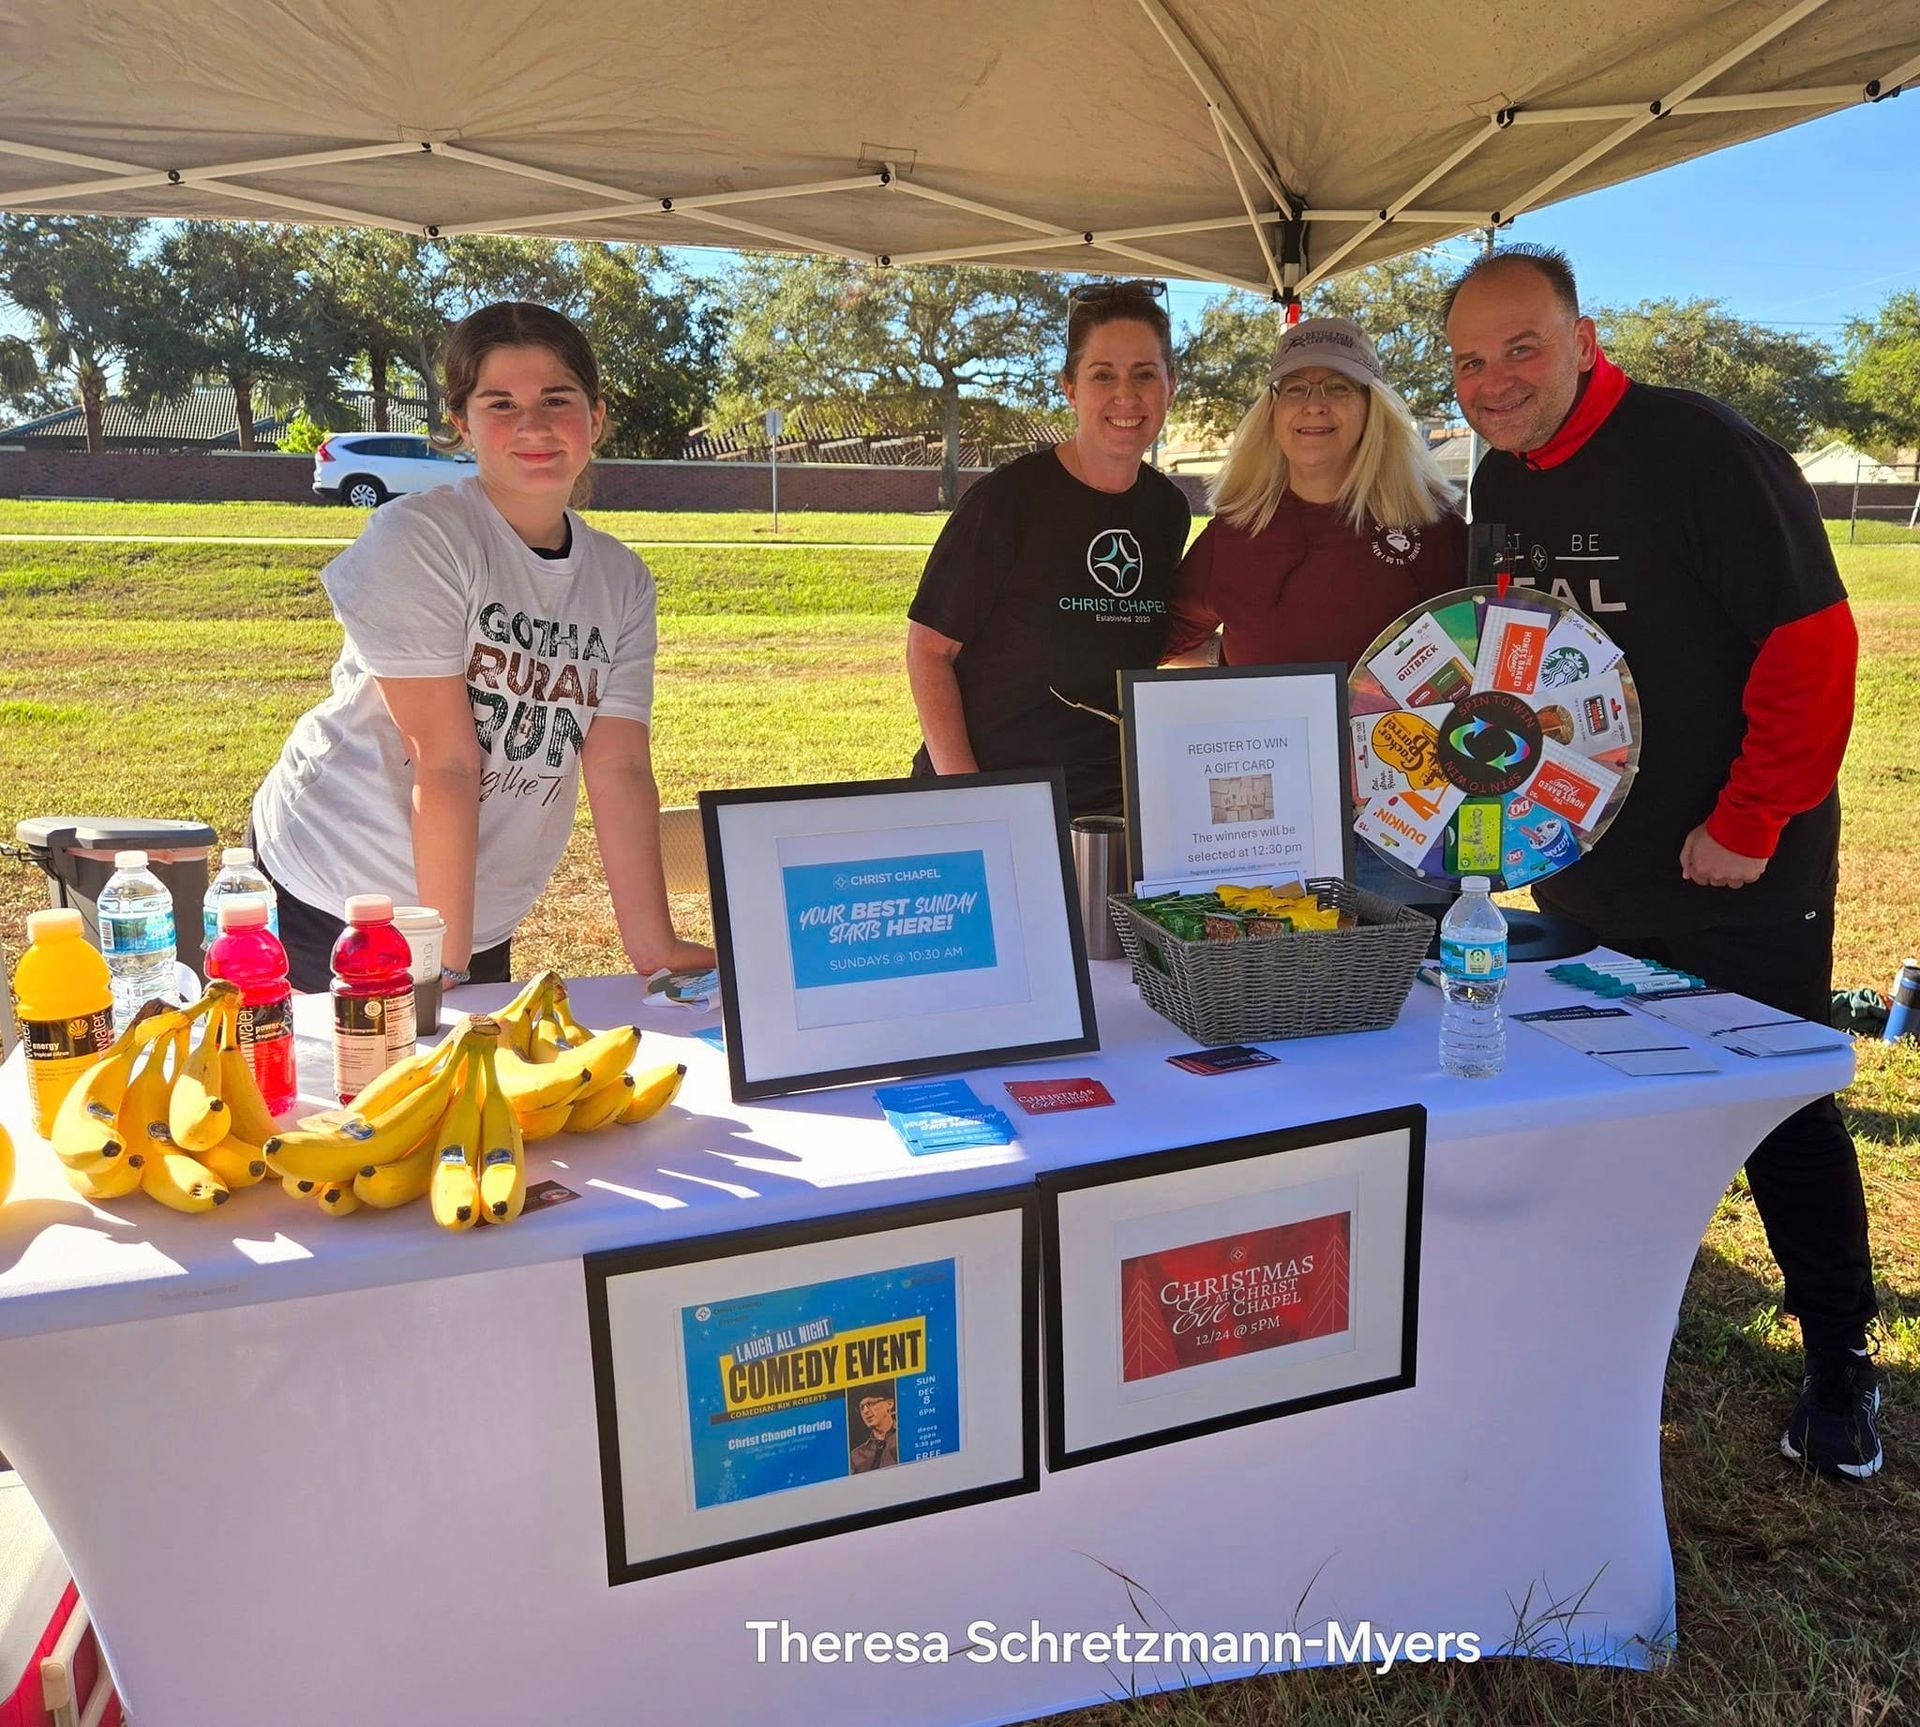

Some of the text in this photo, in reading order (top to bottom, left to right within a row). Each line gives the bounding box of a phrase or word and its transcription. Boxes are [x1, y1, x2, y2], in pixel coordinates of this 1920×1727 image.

[1571, 534, 1599, 552] BE
[1059, 597, 1167, 614] CHRIST CHAPEL
[1096, 614, 1132, 623] Established
[479, 602, 611, 664] GOTHA
[1398, 644, 1439, 682] OUTBACK
[466, 642, 602, 707] RURAL
[1459, 697, 1489, 716] SPIN
[1493, 696, 1510, 707] TO
[1188, 737, 1288, 755] REGISTER TO WIN
[1383, 718, 1430, 757] Barrel
[1378, 729, 1423, 771] Cracker
[1204, 759, 1275, 774] A GIFT CARD
[1470, 782, 1486, 793] TO
[1491, 772, 1521, 792] SPIN
[1192, 824, 1296, 844] The winners will be
[1374, 808, 1427, 845] DUNKIN'
[1188, 843, 1303, 863] selected at 12:30 pm
[850, 868, 941, 886] CHRIST CHAPEL
[800, 891, 978, 931] YOUR BEST SUNDAY
[829, 914, 953, 945] STARTS HERE!
[829, 947, 963, 971] SUNDAYS @ 10:30 AM
[33, 1042, 59, 1050] energy
[1160, 1255, 1314, 1305] CHRISTMAS
[1215, 1278, 1299, 1304] AT CHRIST
[1172, 1294, 1301, 1335] Eve CHAPEL
[736, 1319, 830, 1362] LAUGH ALL NIGHT
[1196, 1316, 1280, 1346] 12/24 @ 5PM
[728, 1328, 922, 1404] COMEDY EVENT
[916, 1376, 936, 1385] SUN
[918, 1387, 935, 1397] DEC
[923, 1395, 930, 1404] 8
[730, 1394, 827, 1419] COMEDIAN: RIK ROBERTS
[918, 1407, 936, 1416] 6PM
[728, 1436, 760, 1450] Christ
[761, 1427, 796, 1444] Chapel
[798, 1419, 832, 1435] Florida
[930, 1438, 942, 1446] pm
[915, 1449, 942, 1461] FREE
